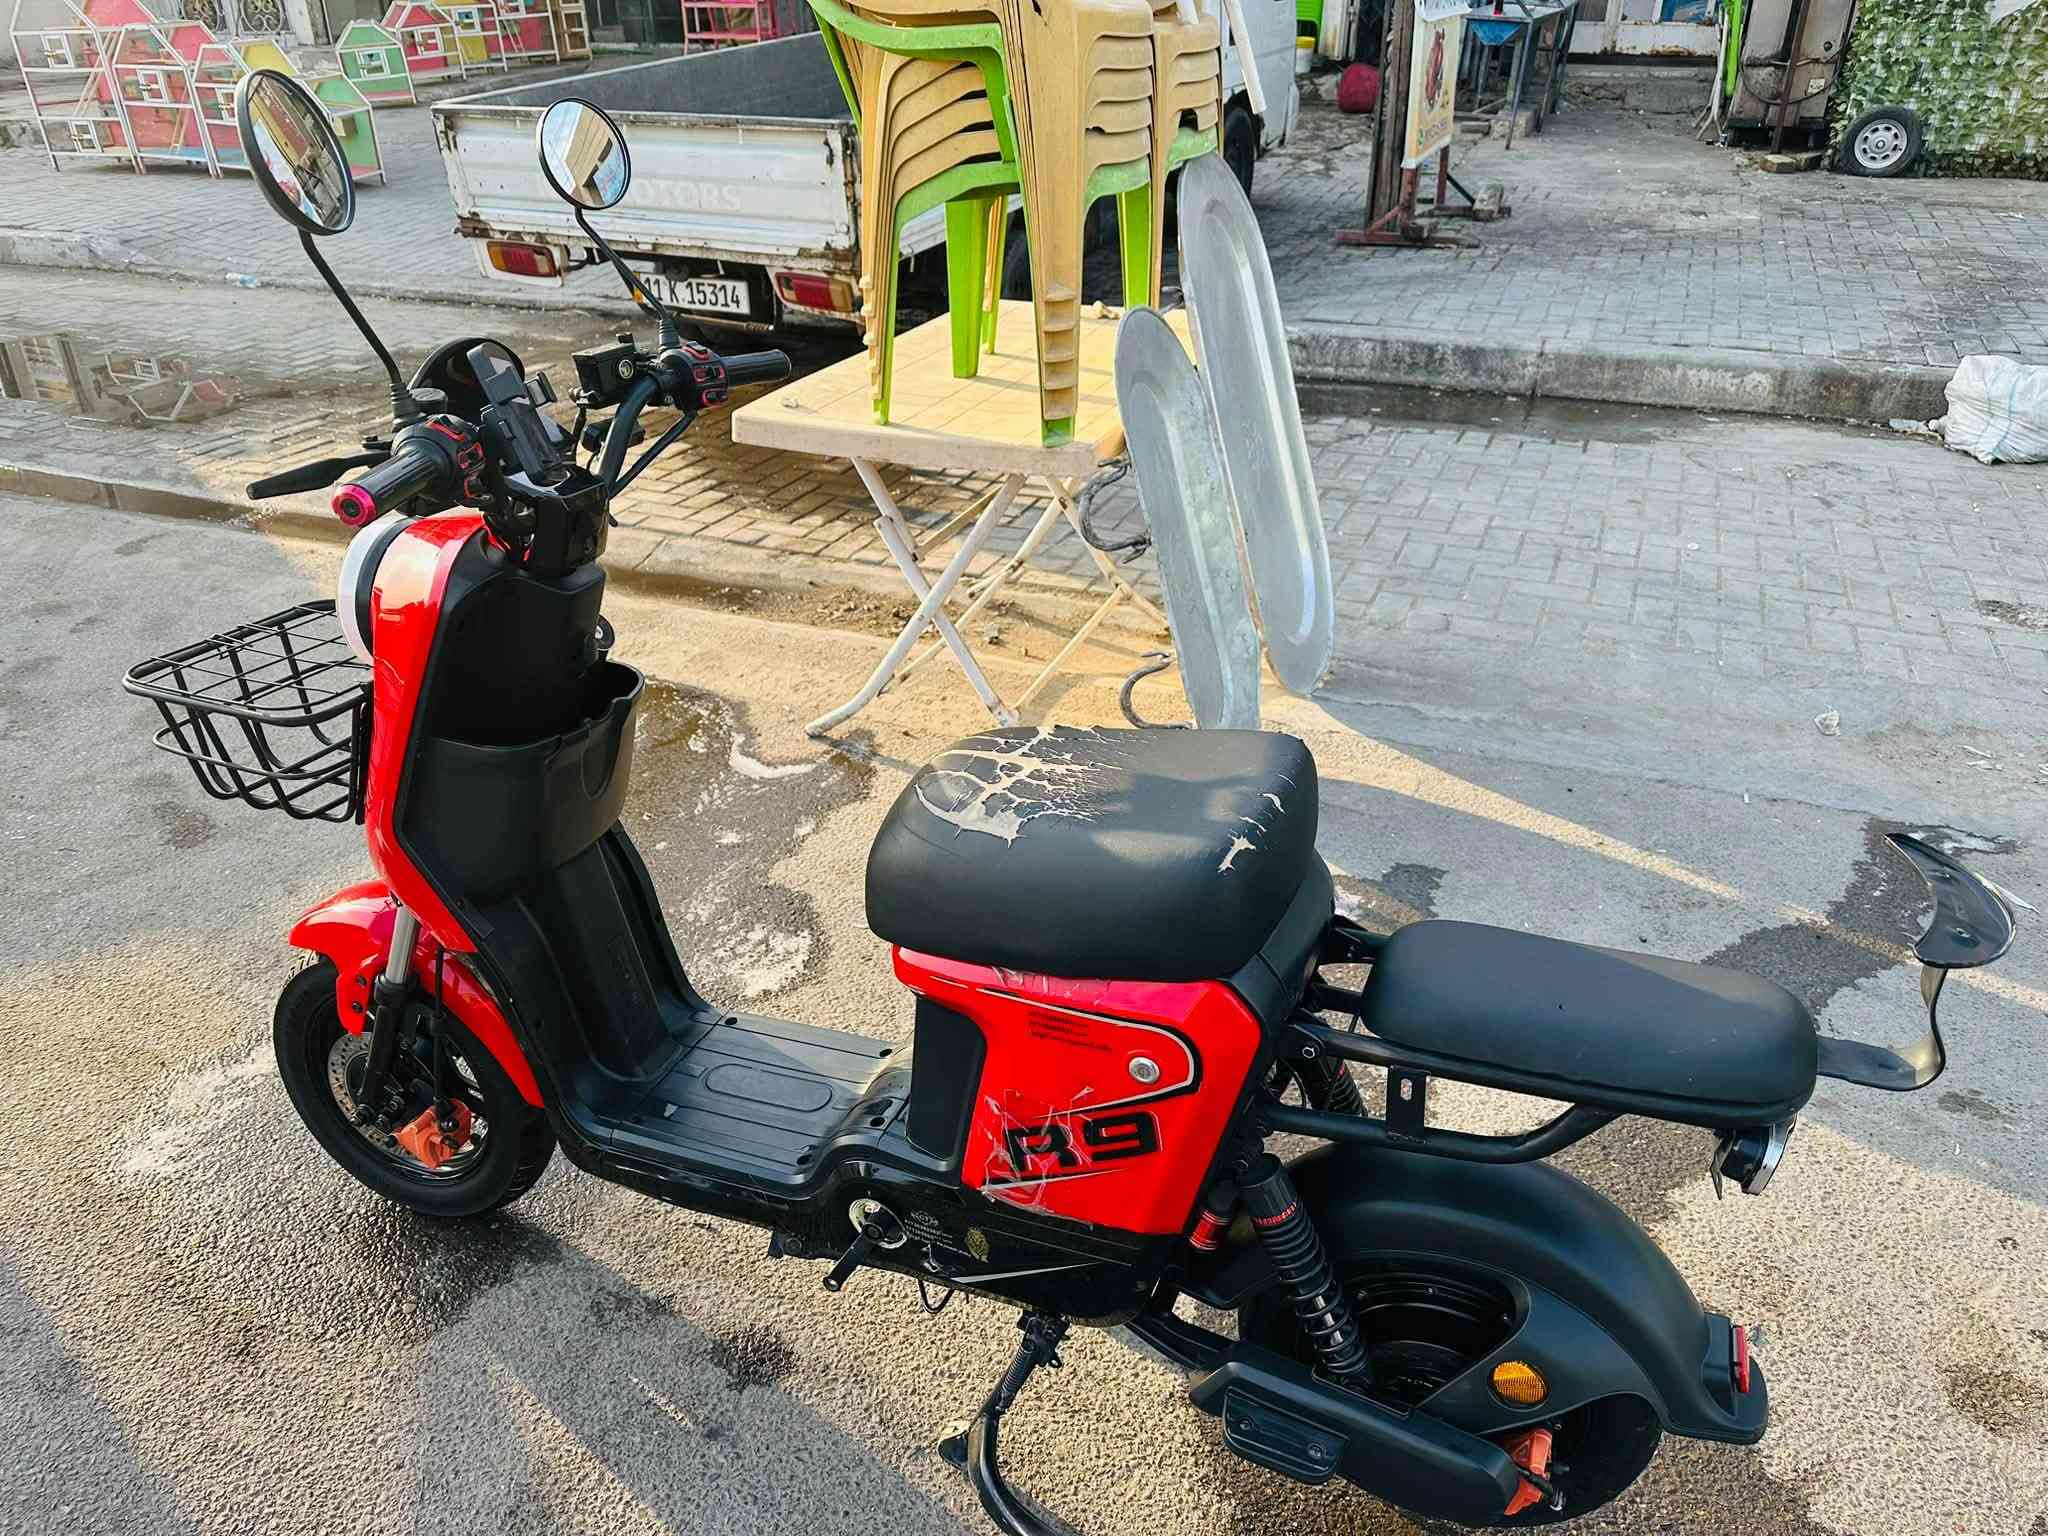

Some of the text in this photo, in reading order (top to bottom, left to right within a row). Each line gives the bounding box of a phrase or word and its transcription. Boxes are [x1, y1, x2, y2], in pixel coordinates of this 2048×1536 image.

[630, 177, 741, 211] OTORS
[643, 277, 741, 309] 11 K 15314
[1004, 1112, 1160, 1172] R9
